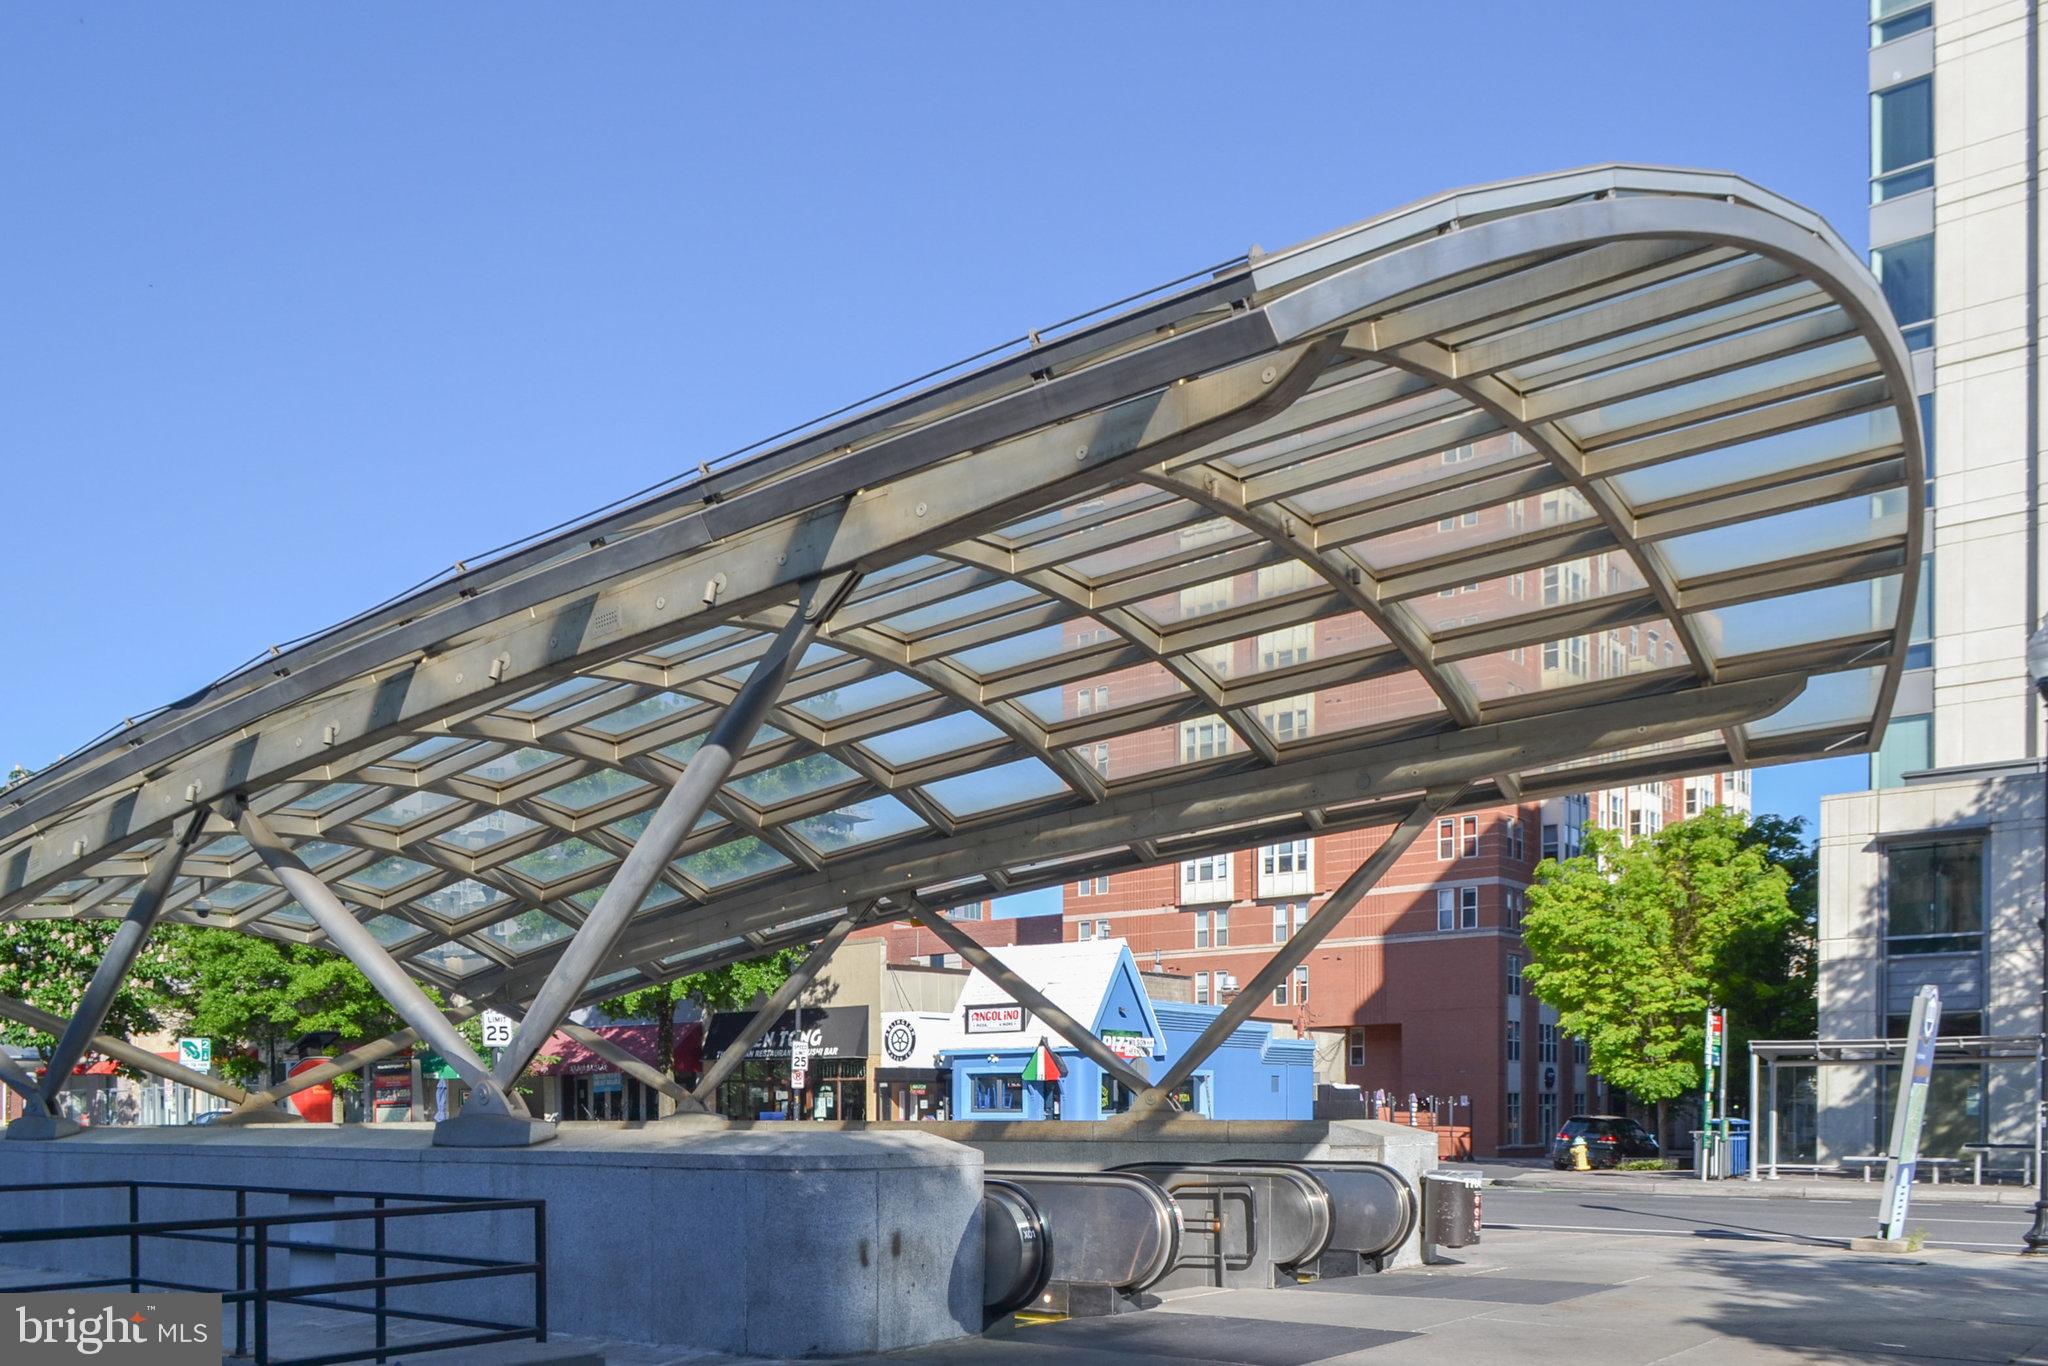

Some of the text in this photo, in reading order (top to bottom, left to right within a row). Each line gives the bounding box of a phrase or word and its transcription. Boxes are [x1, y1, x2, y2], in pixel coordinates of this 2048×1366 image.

[486, 1025, 509, 1041] 25
[755, 1049, 792, 1057] RESTAURAN
[823, 1046, 838, 1055] BAR
[794, 1056, 807, 1067] 25
